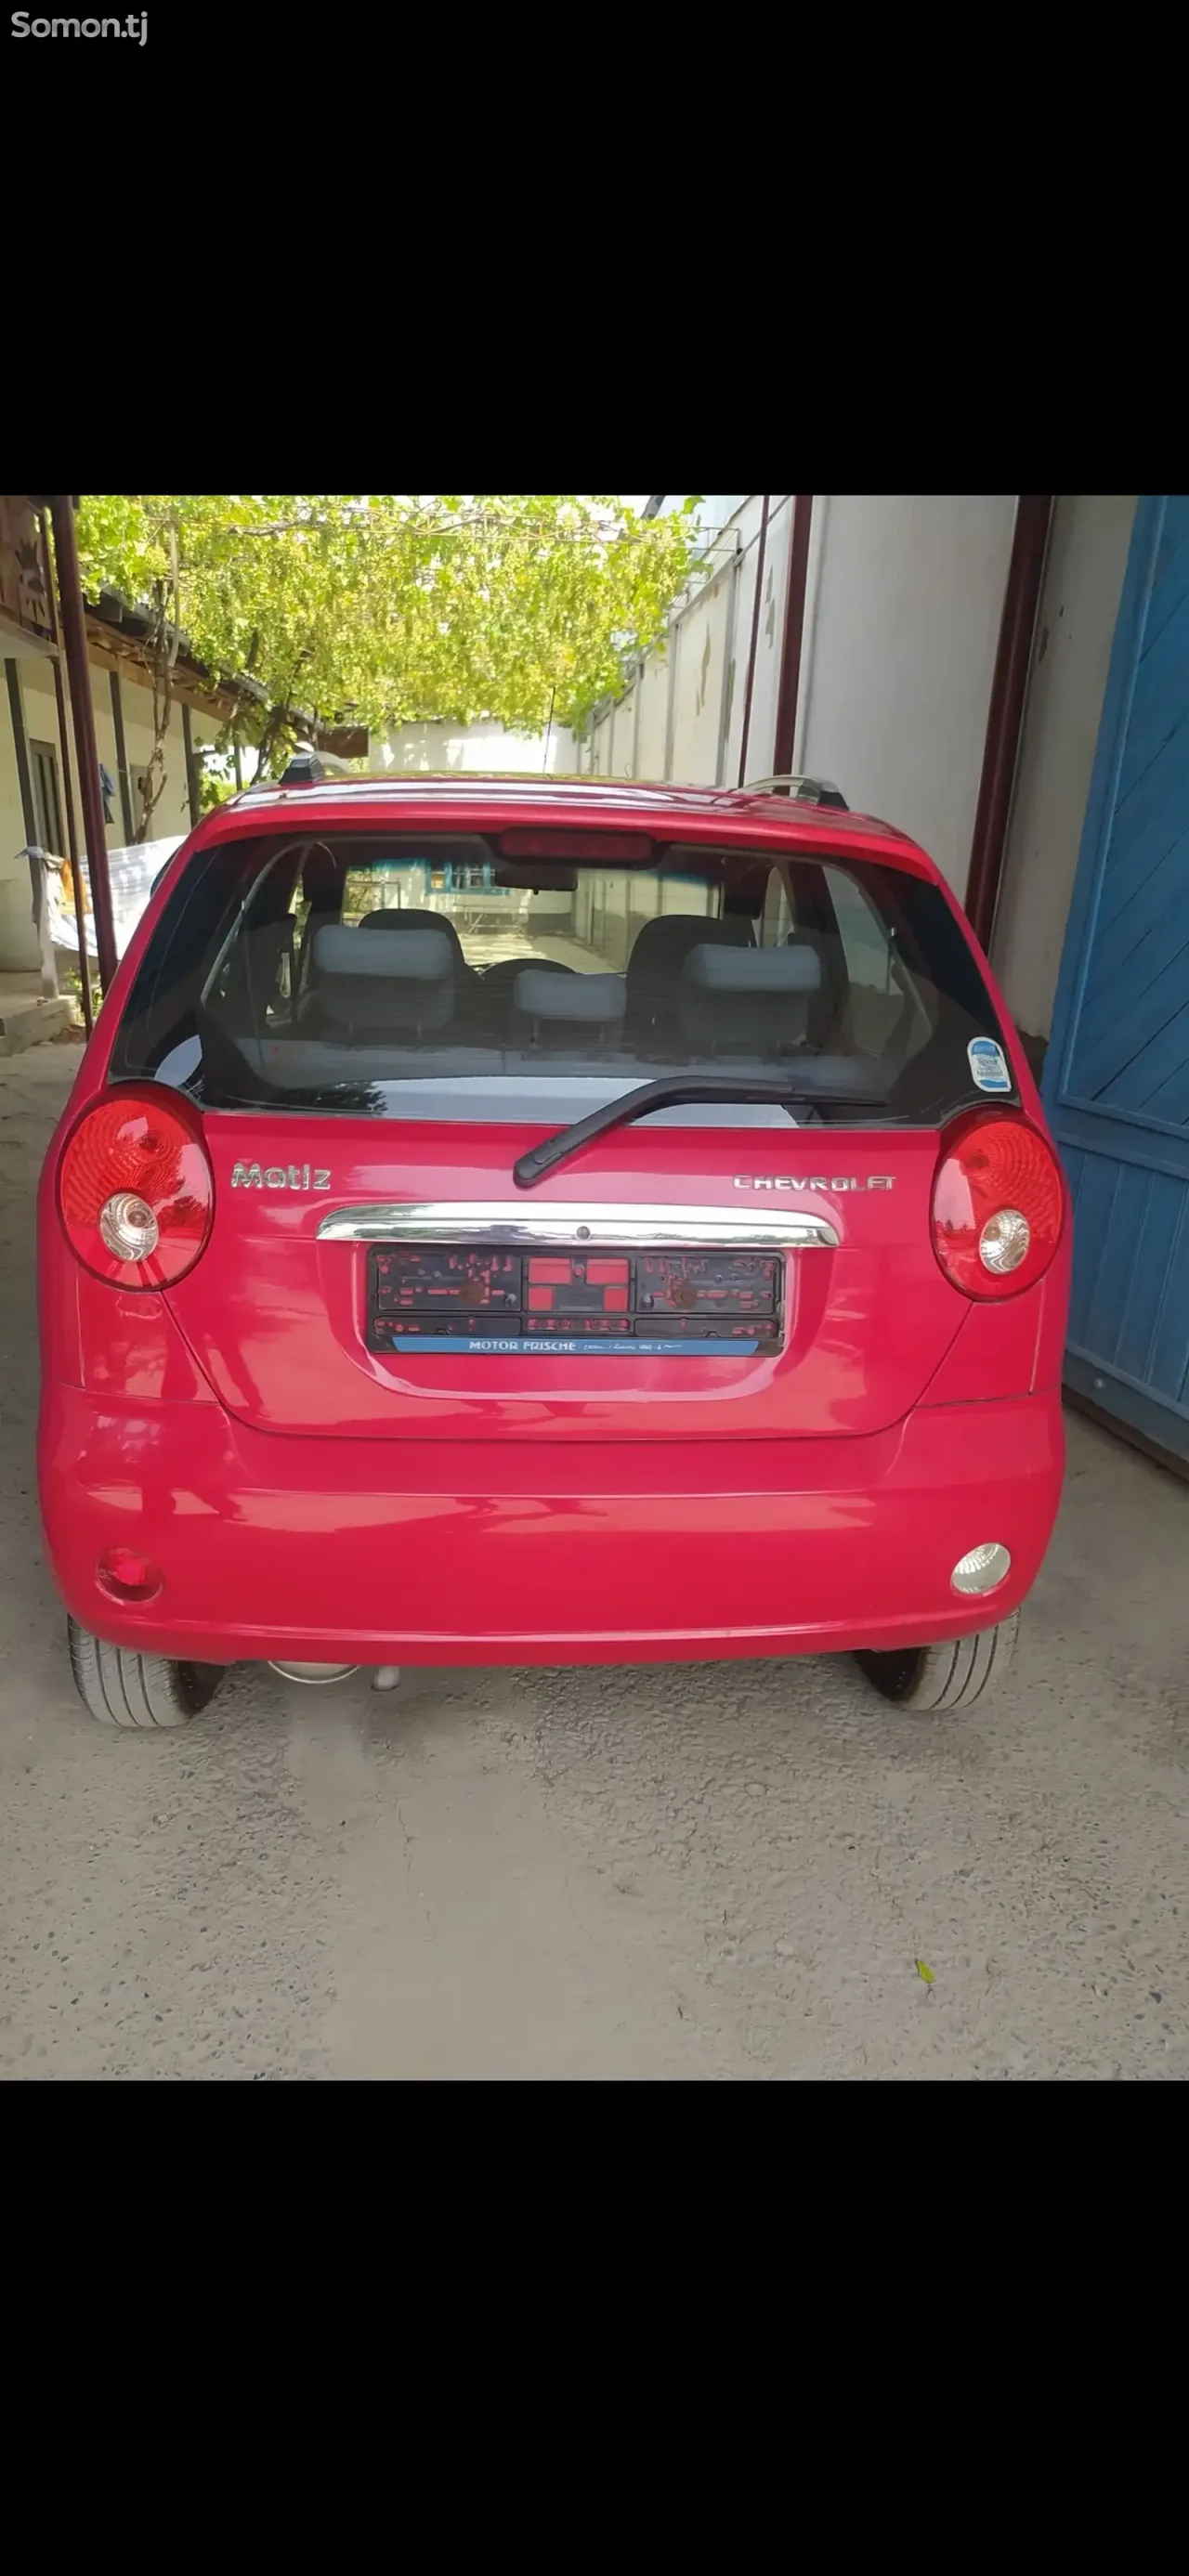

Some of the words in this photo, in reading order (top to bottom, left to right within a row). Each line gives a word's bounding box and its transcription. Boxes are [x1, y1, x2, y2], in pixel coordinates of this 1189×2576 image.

[230, 1163, 332, 1190] Matiz
[733, 1175, 896, 1190] CHEVROLET
[469, 1341, 518, 1350] MOTOR
[523, 1341, 576, 1350] FRISCHE
